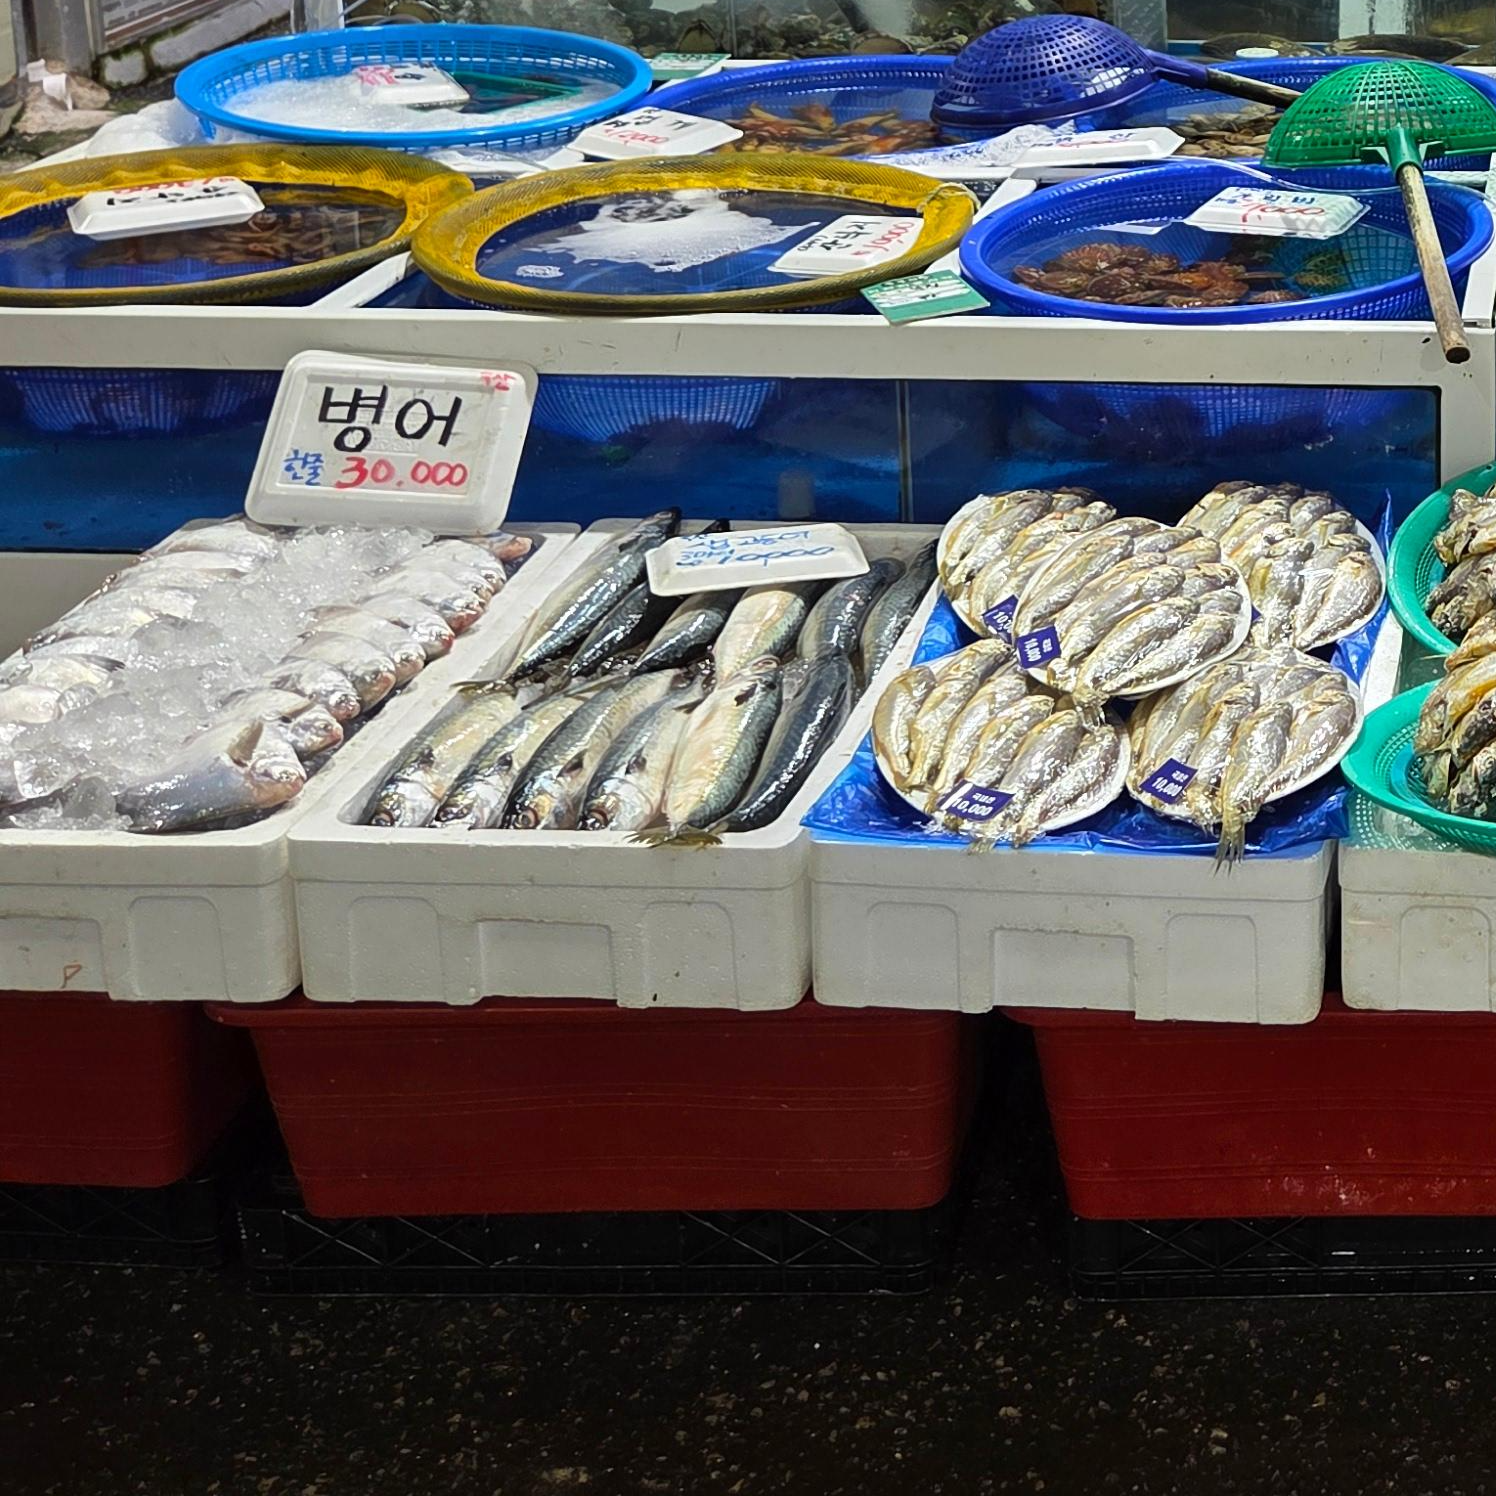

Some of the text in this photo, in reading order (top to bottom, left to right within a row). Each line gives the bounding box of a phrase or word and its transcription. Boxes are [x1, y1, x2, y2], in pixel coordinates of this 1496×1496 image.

[318, 384, 462, 453] 병어
[1151, 776, 1183, 797] 10,000
[951, 797, 994, 817] 10,000
